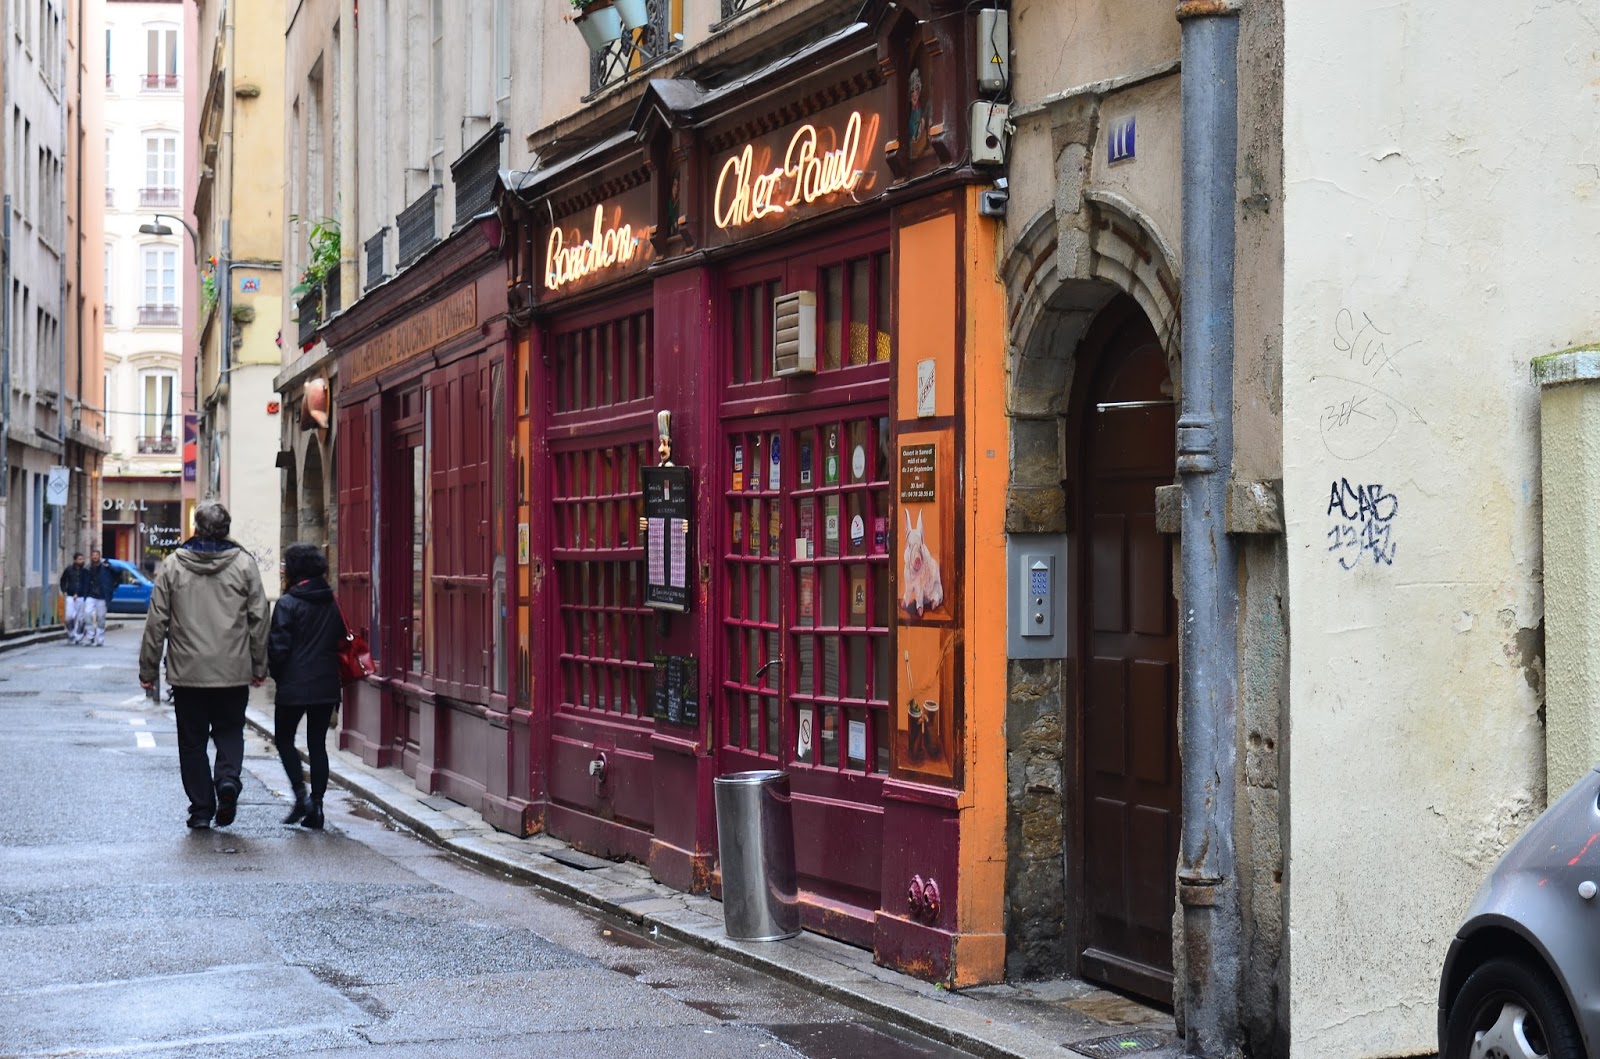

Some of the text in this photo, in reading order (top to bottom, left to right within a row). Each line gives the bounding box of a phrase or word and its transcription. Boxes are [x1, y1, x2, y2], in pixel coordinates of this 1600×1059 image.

[714, 111, 863, 228] Chez Paul
[545, 204, 639, 291] Bouchon
[396, 312, 432, 358] BOUCHON
[436, 288, 474, 339] LYONNAIS
[1327, 477, 1398, 522] ACAB
